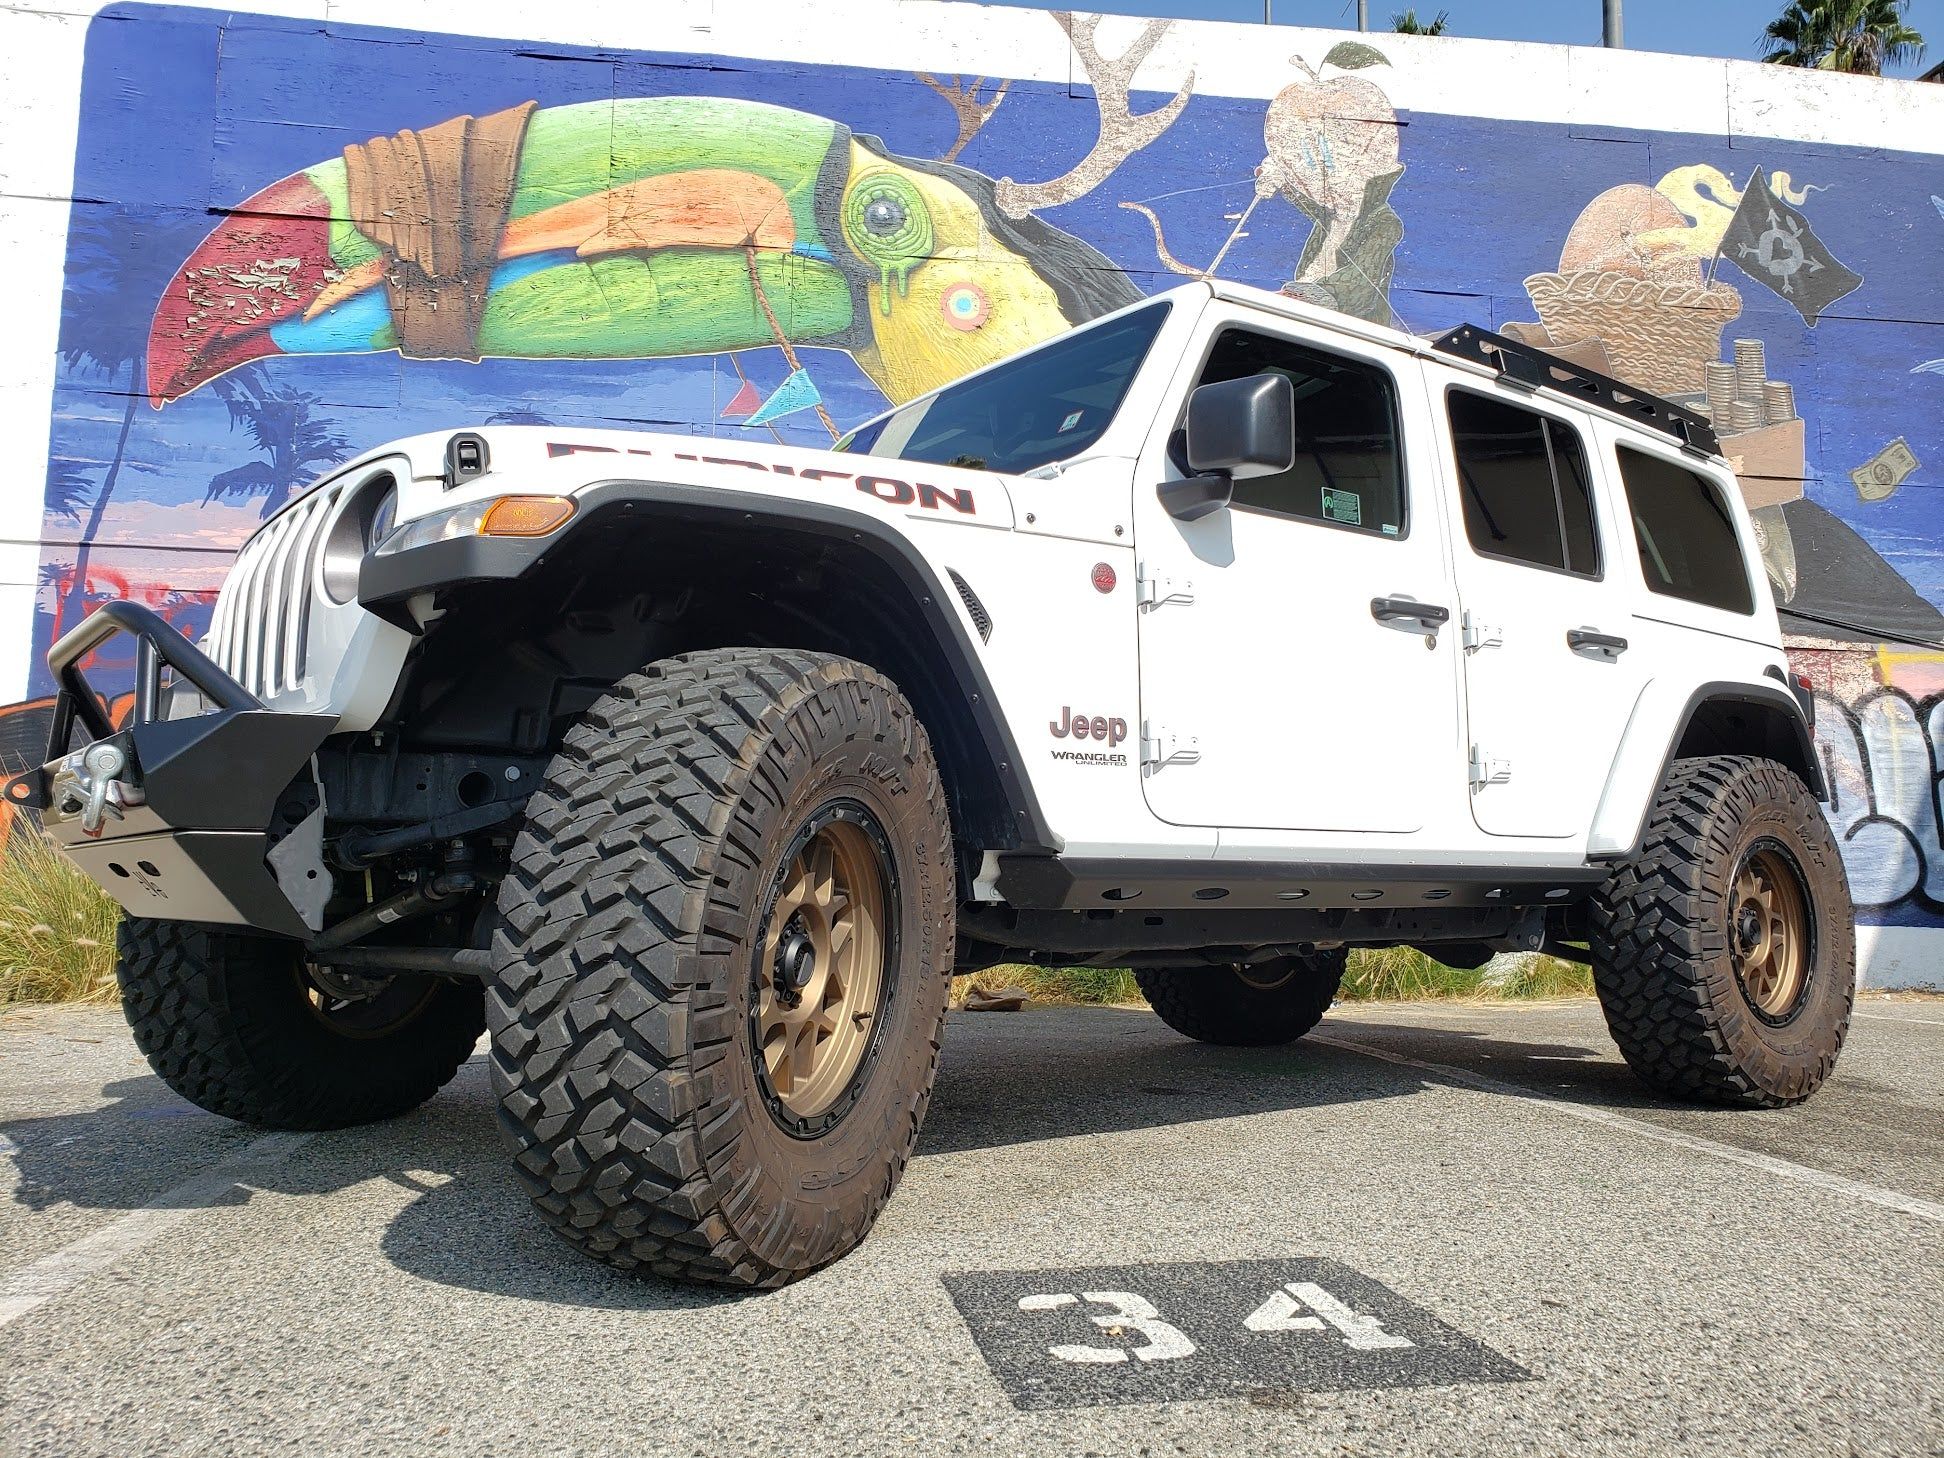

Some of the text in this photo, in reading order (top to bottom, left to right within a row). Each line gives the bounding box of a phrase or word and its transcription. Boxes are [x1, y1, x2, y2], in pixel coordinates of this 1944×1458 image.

[1049, 705, 1128, 748] Jeep
[1050, 750, 1127, 762] WRANGLER
[1018, 1282, 1417, 1364] 34
